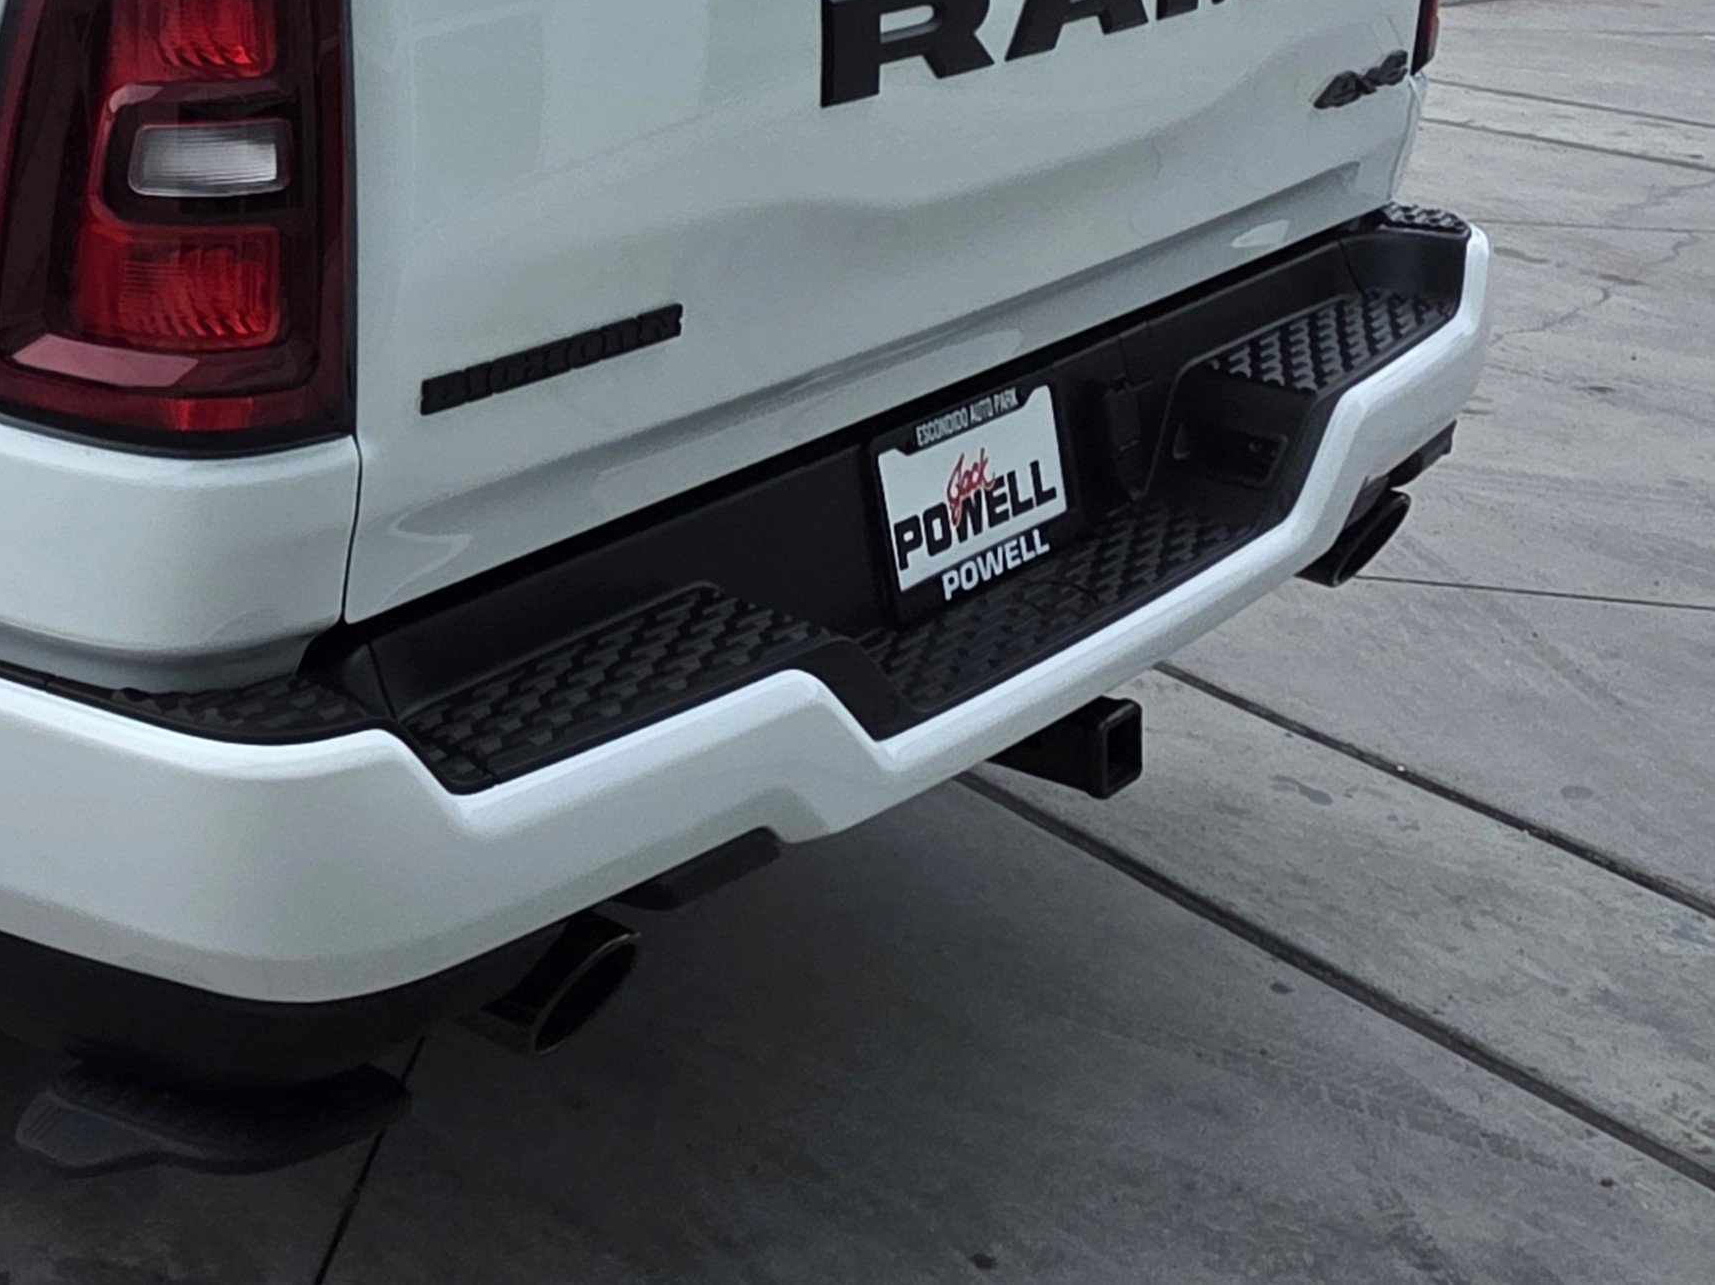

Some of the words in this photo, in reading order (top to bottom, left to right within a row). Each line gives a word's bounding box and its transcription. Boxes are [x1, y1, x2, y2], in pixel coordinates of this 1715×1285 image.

[915, 406, 969, 447] ESCONDIDO
[970, 396, 994, 424] AUTO
[994, 387, 1019, 413] PARK
[894, 460, 1057, 571] POWELL
[941, 528, 1050, 601] POWELL
